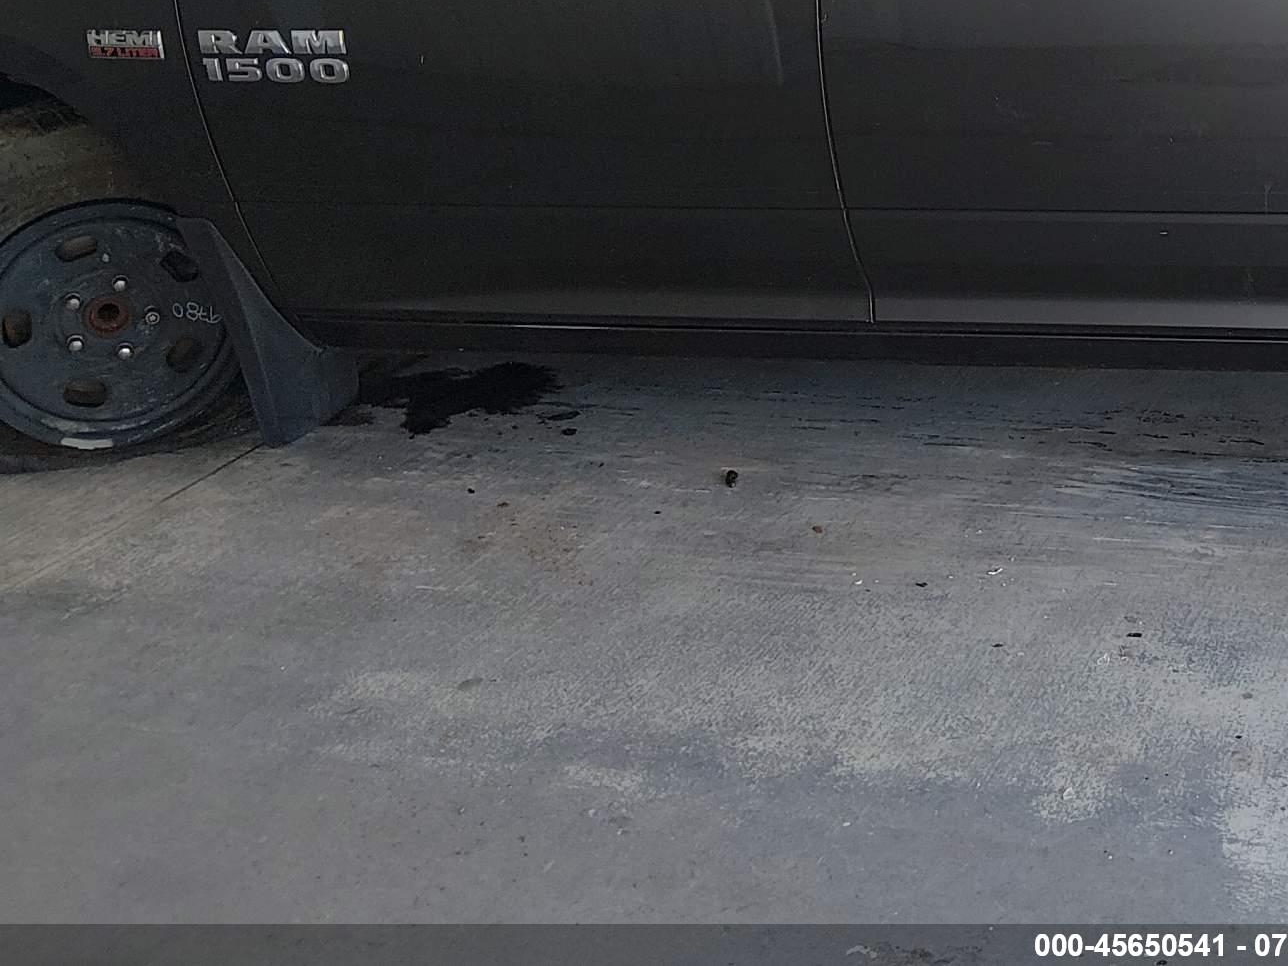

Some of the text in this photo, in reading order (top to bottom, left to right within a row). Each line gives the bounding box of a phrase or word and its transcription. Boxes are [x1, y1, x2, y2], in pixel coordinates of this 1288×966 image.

[87, 29, 163, 46] HEMI
[197, 29, 347, 54] RAM
[203, 57, 350, 83] 1500
